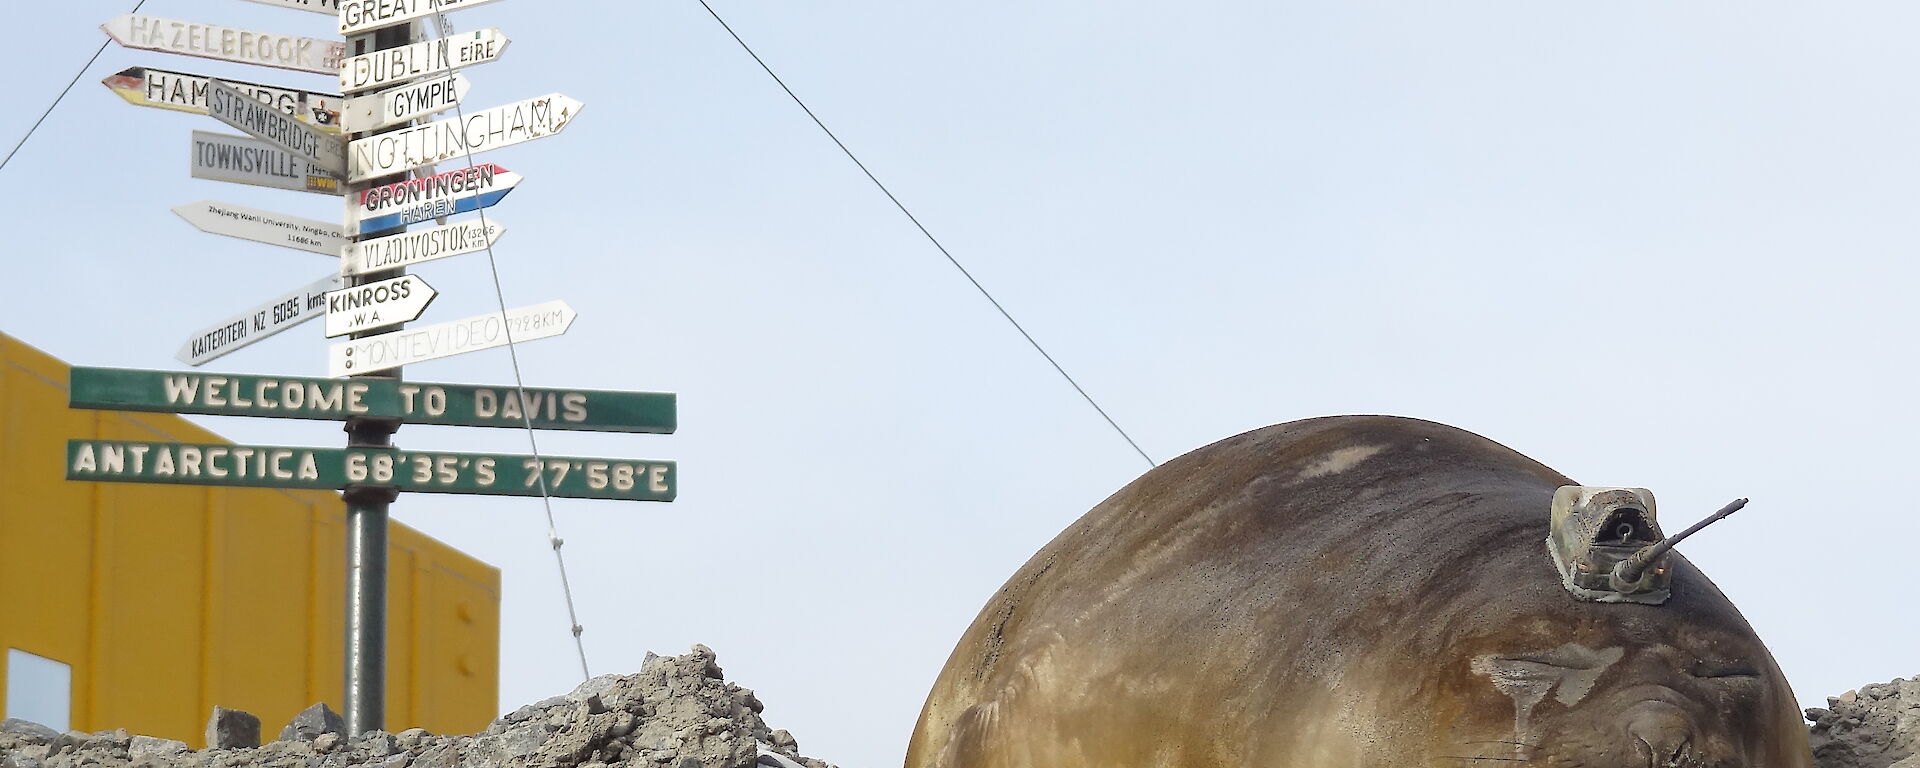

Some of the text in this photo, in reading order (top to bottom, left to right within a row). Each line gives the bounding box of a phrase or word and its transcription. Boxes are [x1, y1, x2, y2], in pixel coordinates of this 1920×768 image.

[130, 16, 312, 66] HAZELBROOK
[354, 38, 448, 87] DUBLIN
[148, 74, 294, 115] HAMRG
[394, 77, 456, 118] GYMPIE
[214, 87, 321, 160] STRAWBRIDGE
[356, 98, 553, 176] NOTTINGHAM
[197, 141, 298, 178] TOWNSVILLE
[366, 164, 494, 211] GRONINGEN
[209, 205, 239, 220] Zhejiang
[241, 212, 261, 222] Wanli
[401, 198, 456, 224] HAREN
[365, 224, 469, 268] VLADIVOSTOK
[330, 278, 412, 314] KINROSS
[192, 291, 326, 359] KAITERITERI NZ 6095 kms
[355, 317, 498, 367] MONTEVIDEO
[163, 375, 588, 422] WELCOME TO DAVIS
[73, 443, 318, 481] ANTARCTICA
